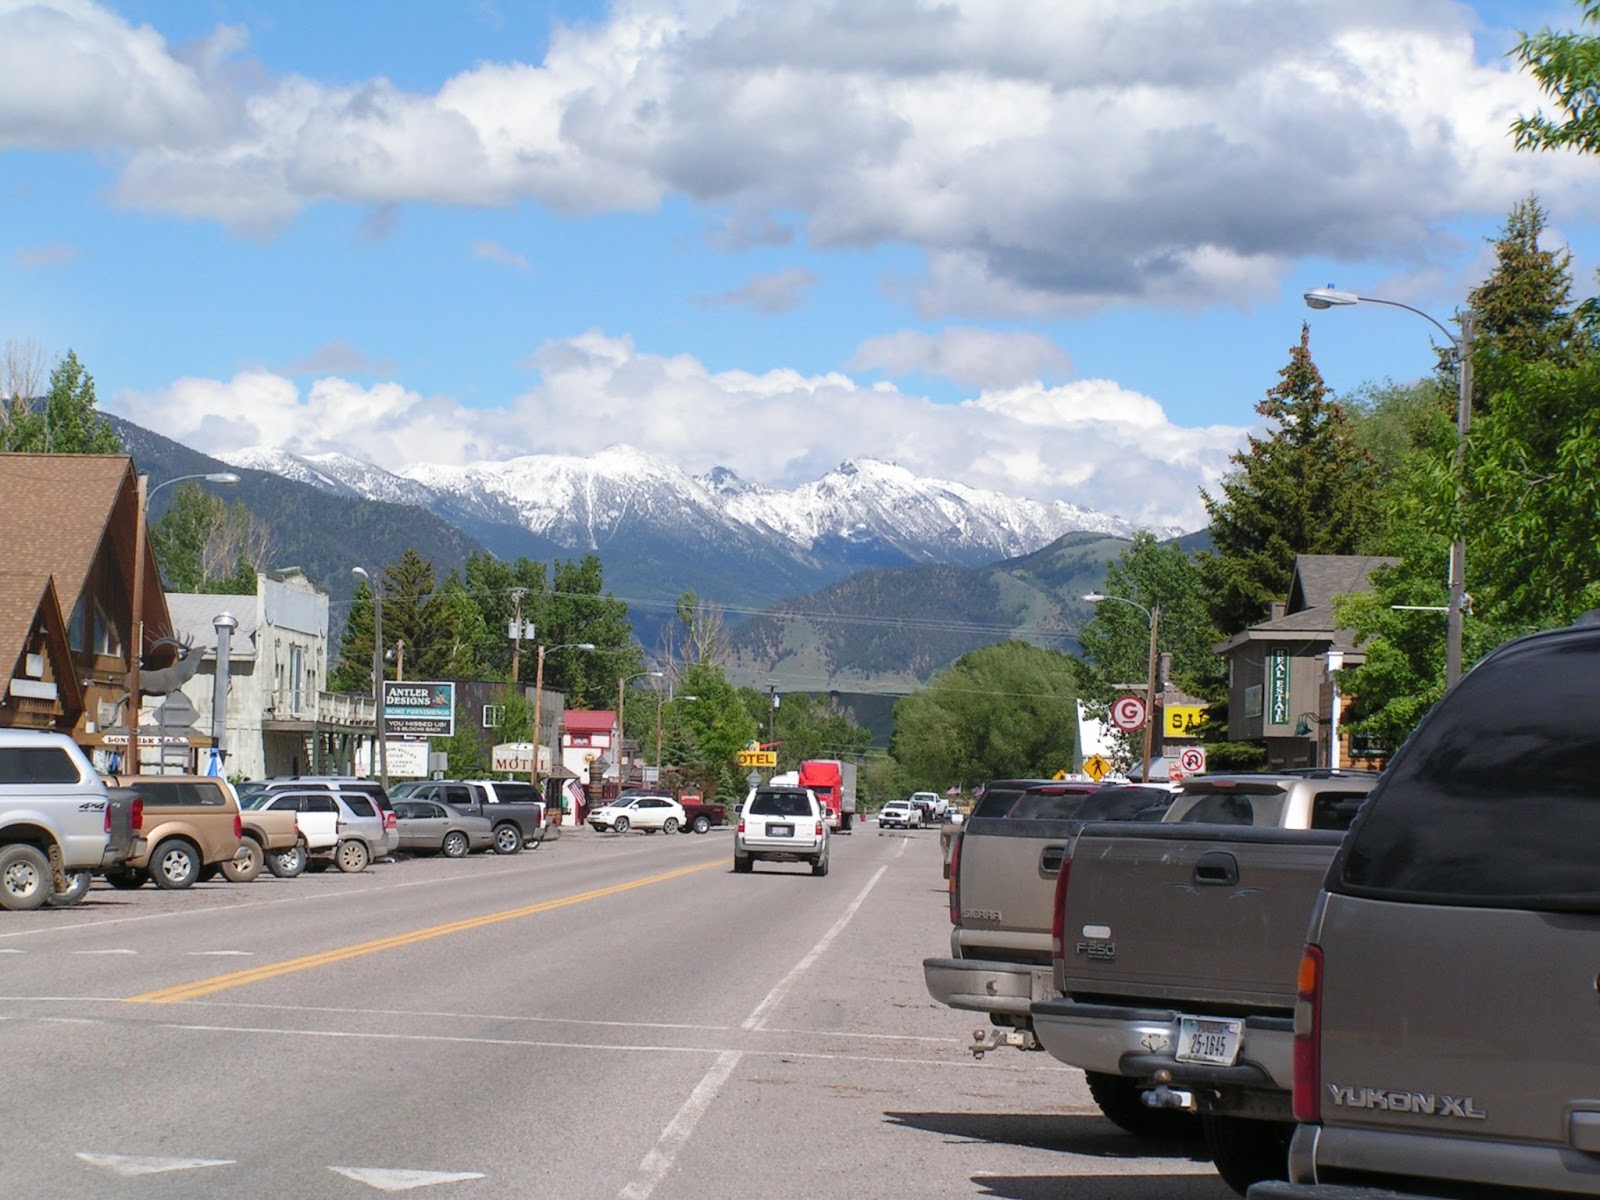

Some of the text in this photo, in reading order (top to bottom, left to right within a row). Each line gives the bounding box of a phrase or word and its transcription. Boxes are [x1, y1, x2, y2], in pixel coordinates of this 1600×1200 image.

[1275, 649, 1285, 678] REAL
[386, 697, 430, 706] DESIGNS
[388, 688, 428, 697] ANTLER
[1274, 680, 1285, 723] ESTATE
[962, 908, 1003, 921] SIERRA
[1190, 1034, 1226, 1056] 25-1645
[1327, 1083, 1487, 1120] YUKON XL
